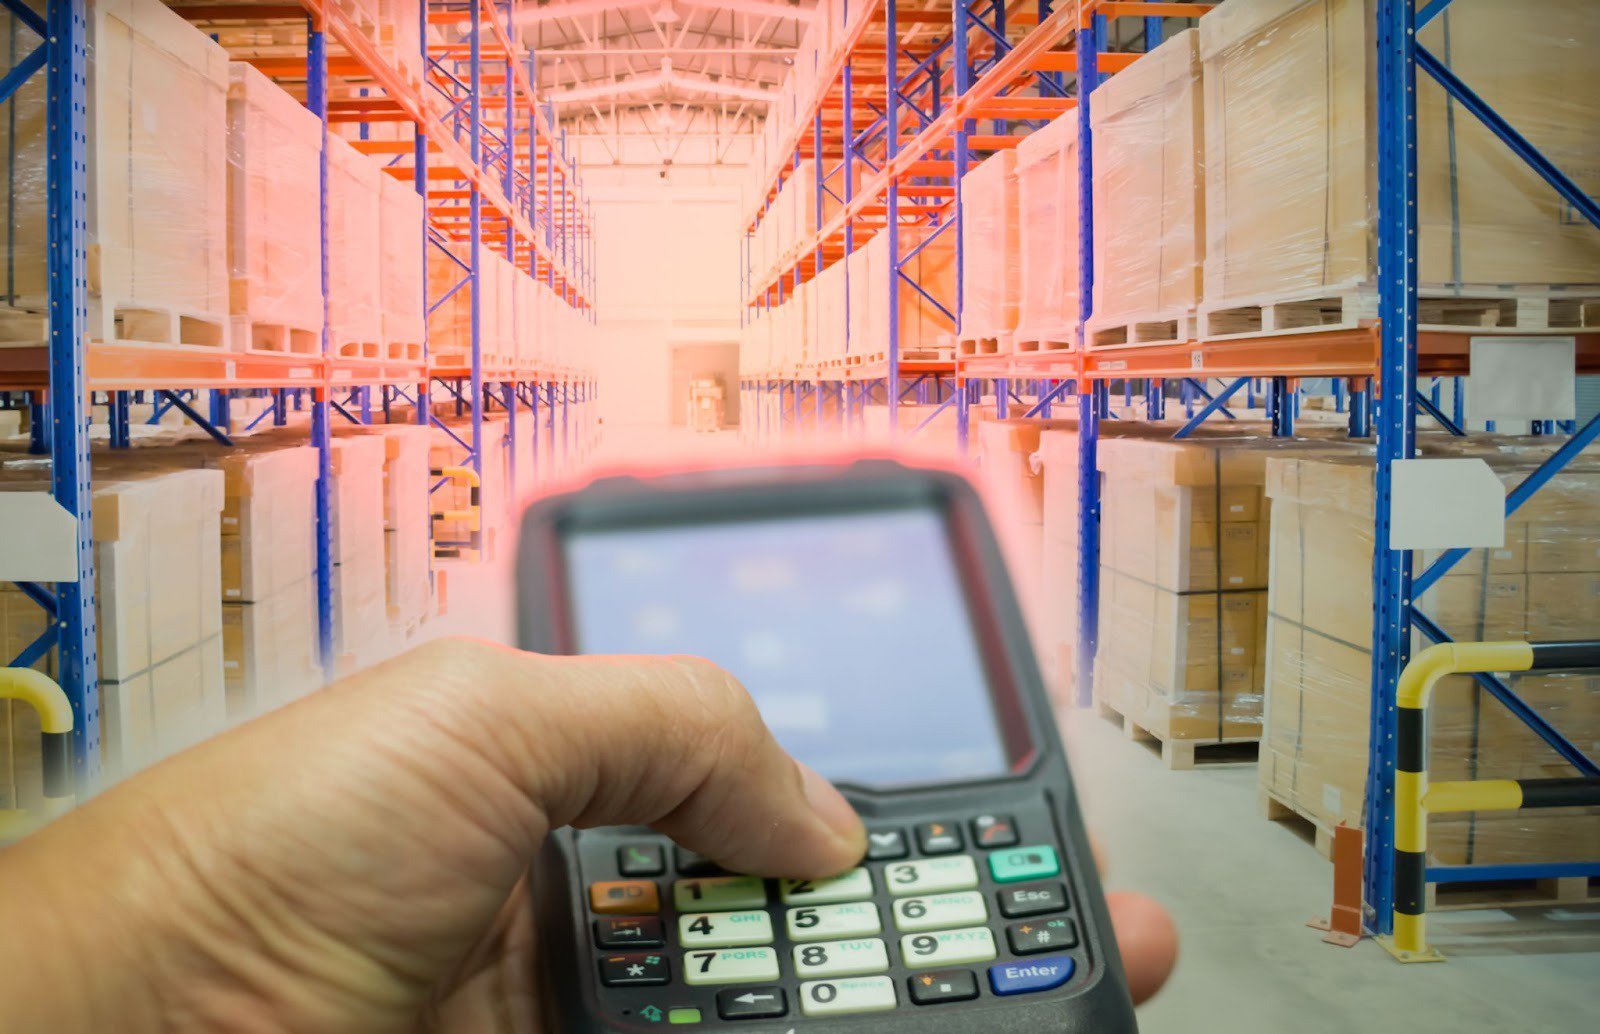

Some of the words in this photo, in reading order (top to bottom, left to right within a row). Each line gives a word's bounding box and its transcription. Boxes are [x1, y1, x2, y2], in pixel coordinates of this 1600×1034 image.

[894, 865, 919, 884] 3
[685, 881, 702, 900] 1
[786, 878, 815, 895] 2
[1013, 890, 1051, 902] Esc
[795, 909, 820, 928] 5
[902, 900, 927, 919] 6
[688, 916, 714, 935] 4
[912, 936, 939, 955] 9
[693, 952, 717, 973] 7
[802, 946, 828, 966] 8
[1005, 966, 1058, 979] Enter
[811, 983, 837, 1003] 0
